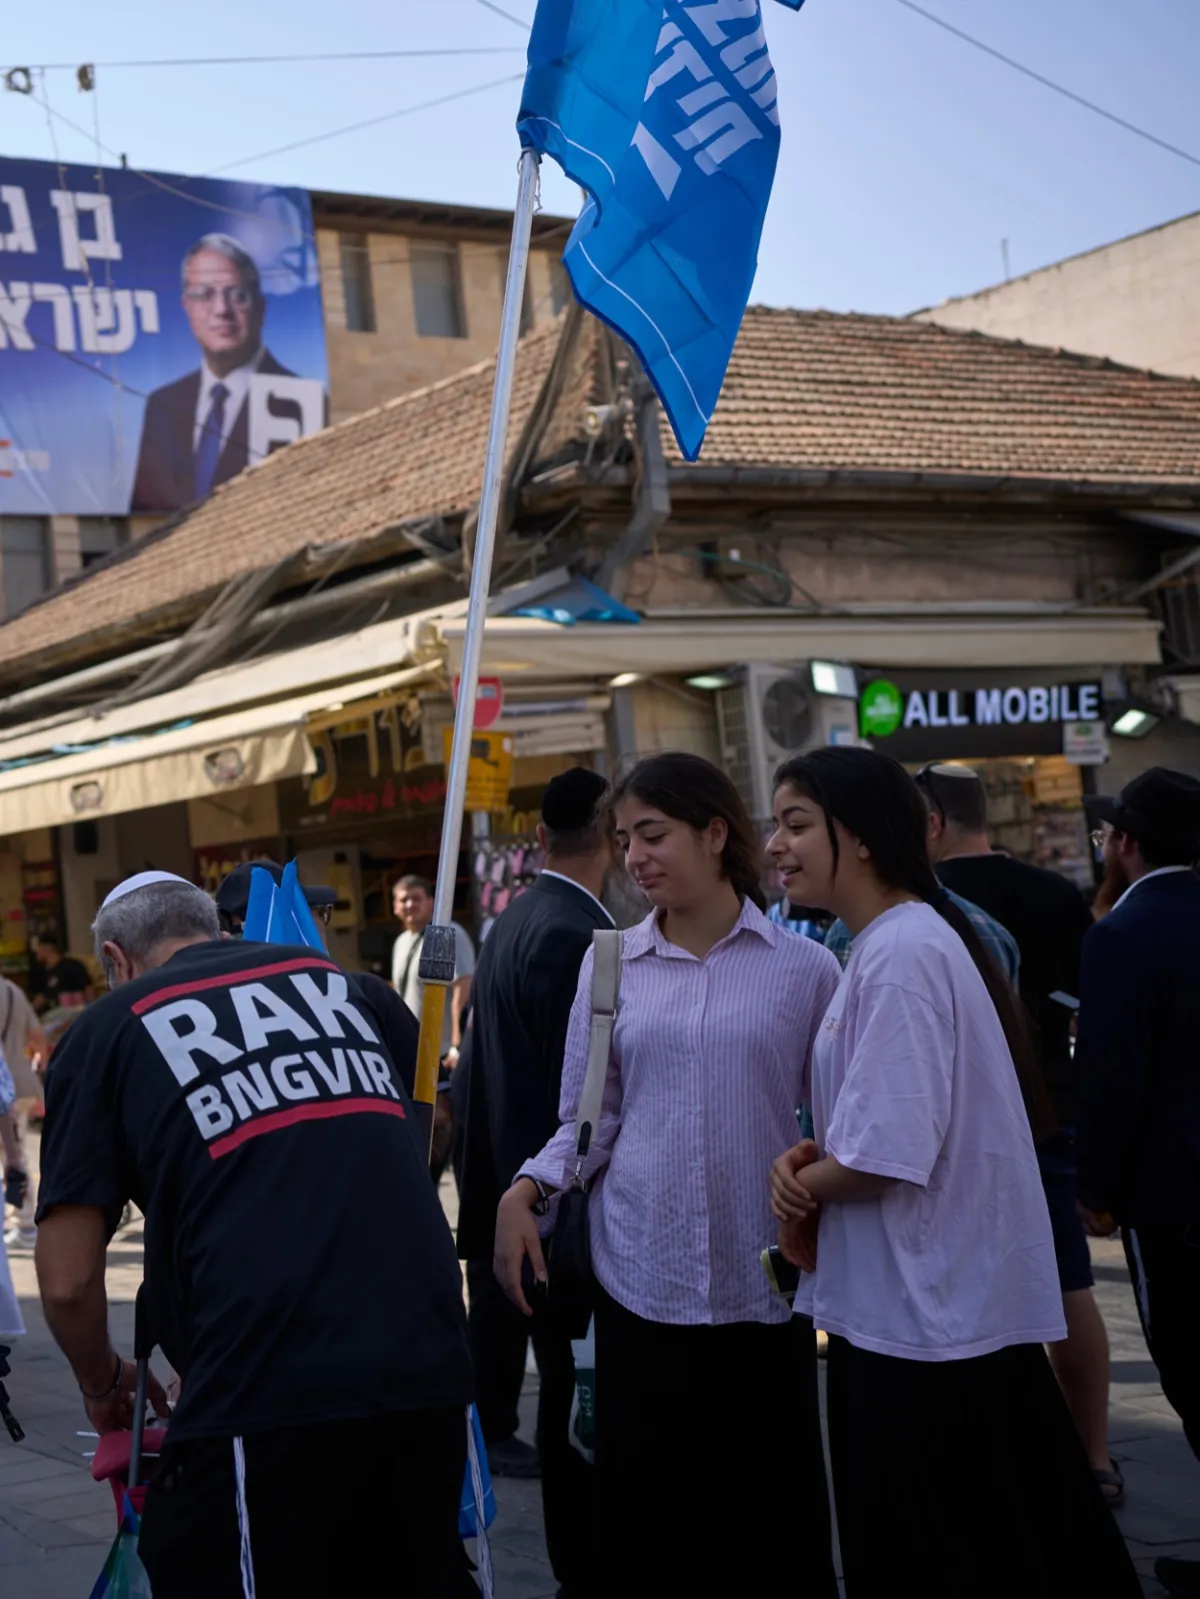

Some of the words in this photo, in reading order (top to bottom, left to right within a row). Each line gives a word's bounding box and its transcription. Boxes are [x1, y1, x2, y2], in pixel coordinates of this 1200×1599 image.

[49, 189, 122, 271] בן
[903, 690, 968, 728] ALL
[975, 685, 1098, 724] MOBILE
[141, 971, 381, 1088] RAK
[185, 1047, 401, 1141] BNGVIR
